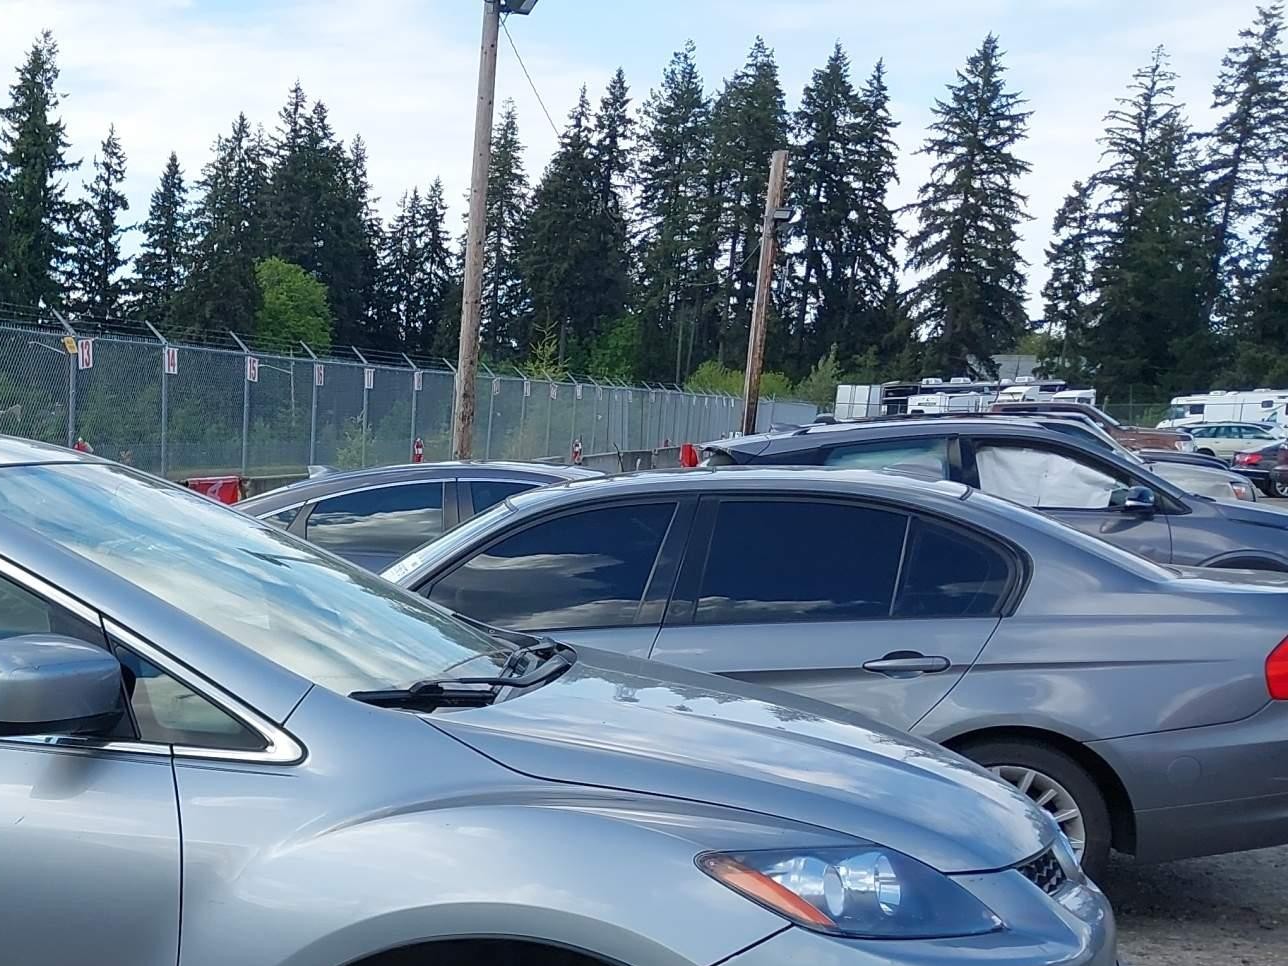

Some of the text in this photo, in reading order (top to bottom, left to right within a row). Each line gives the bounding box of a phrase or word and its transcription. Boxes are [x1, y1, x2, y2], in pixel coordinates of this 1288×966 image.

[80, 341, 90, 367] 13
[167, 350, 176, 373] 14
[248, 358, 256, 380] 15
